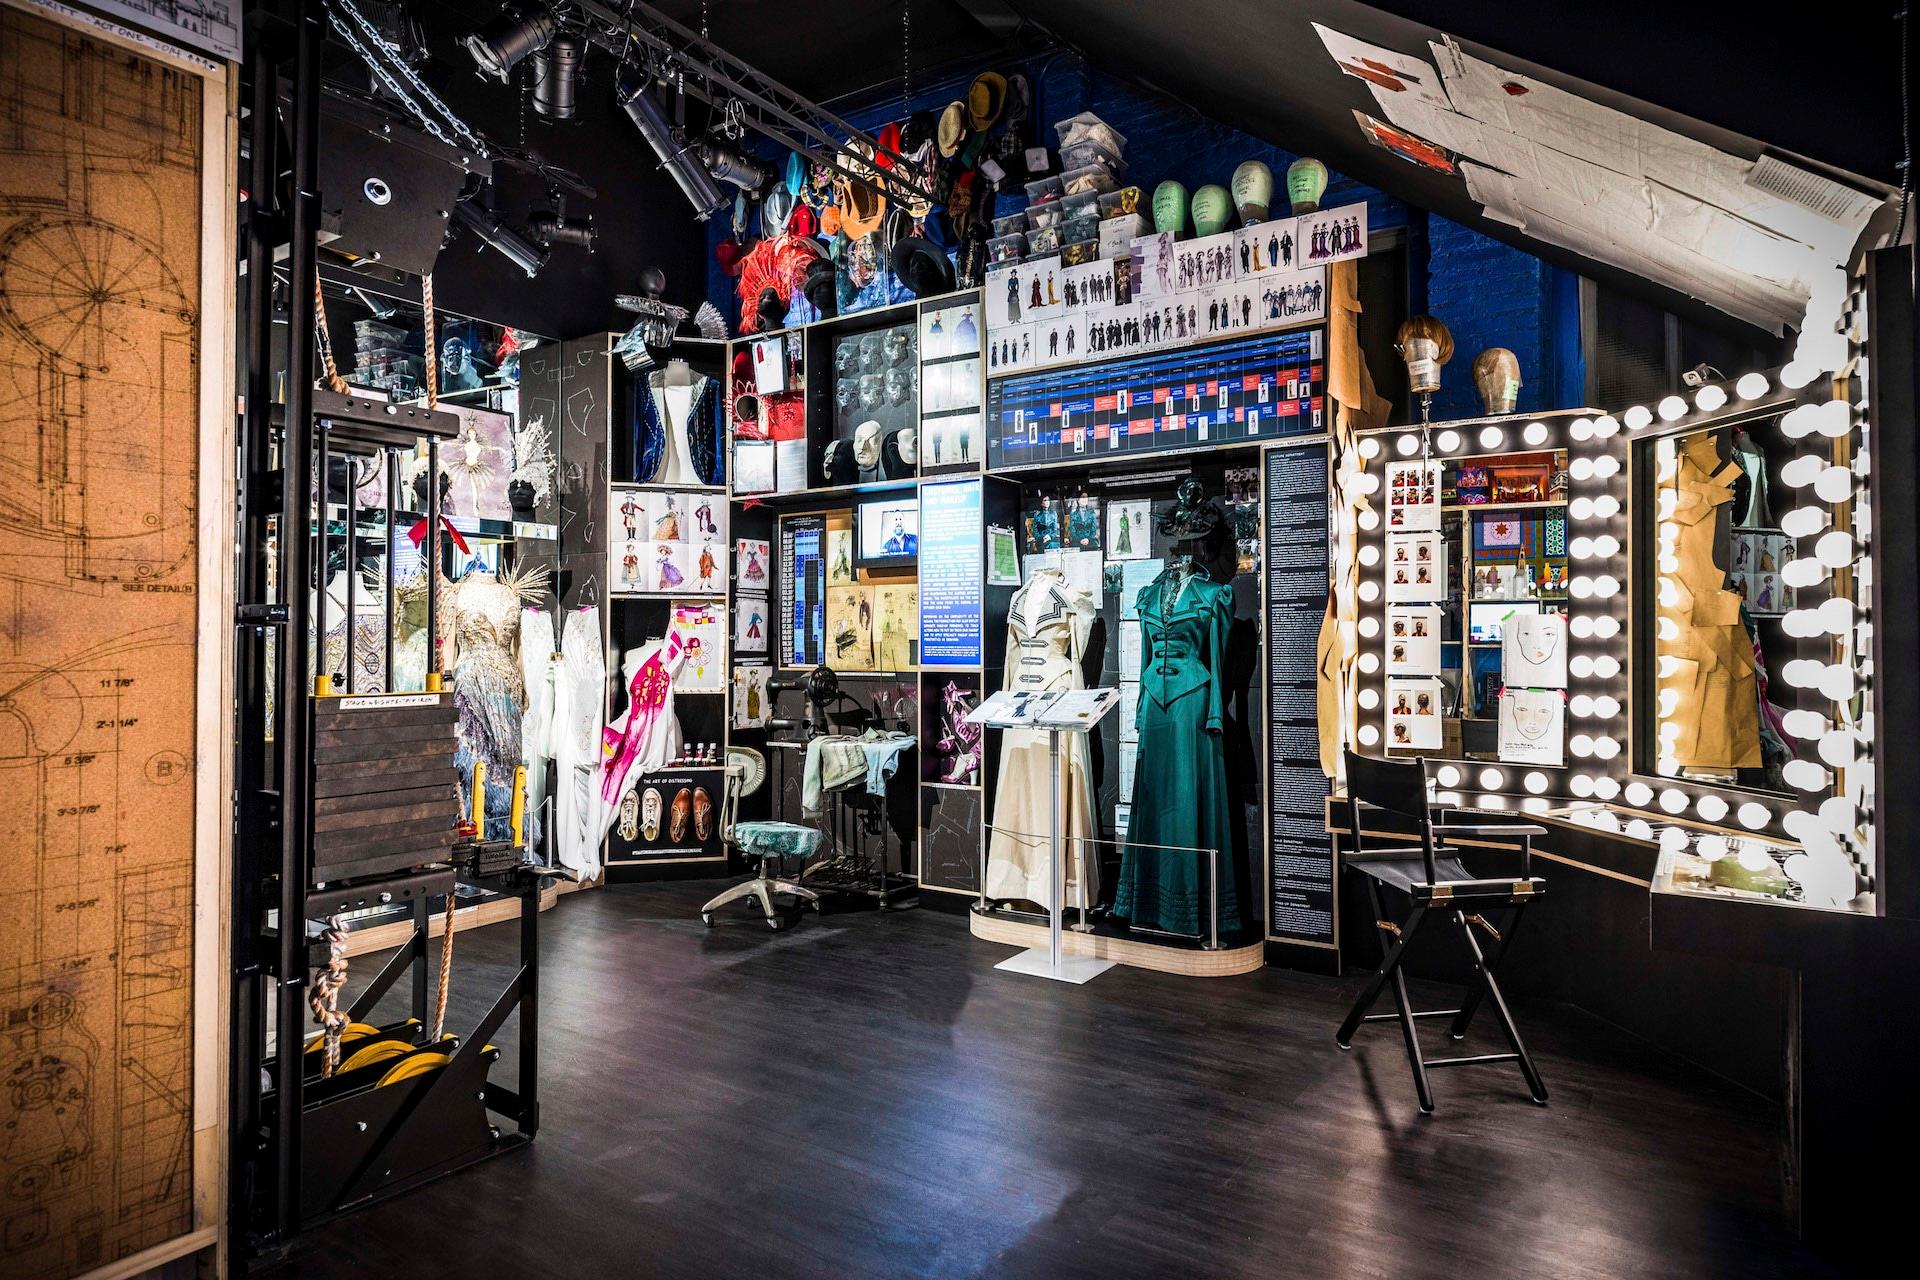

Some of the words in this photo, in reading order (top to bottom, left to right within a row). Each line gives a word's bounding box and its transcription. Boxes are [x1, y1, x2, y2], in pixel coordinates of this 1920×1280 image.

[122, 584, 144, 592] SEE
[147, 584, 182, 593] DETAIL
[157, 761, 173, 777] B
